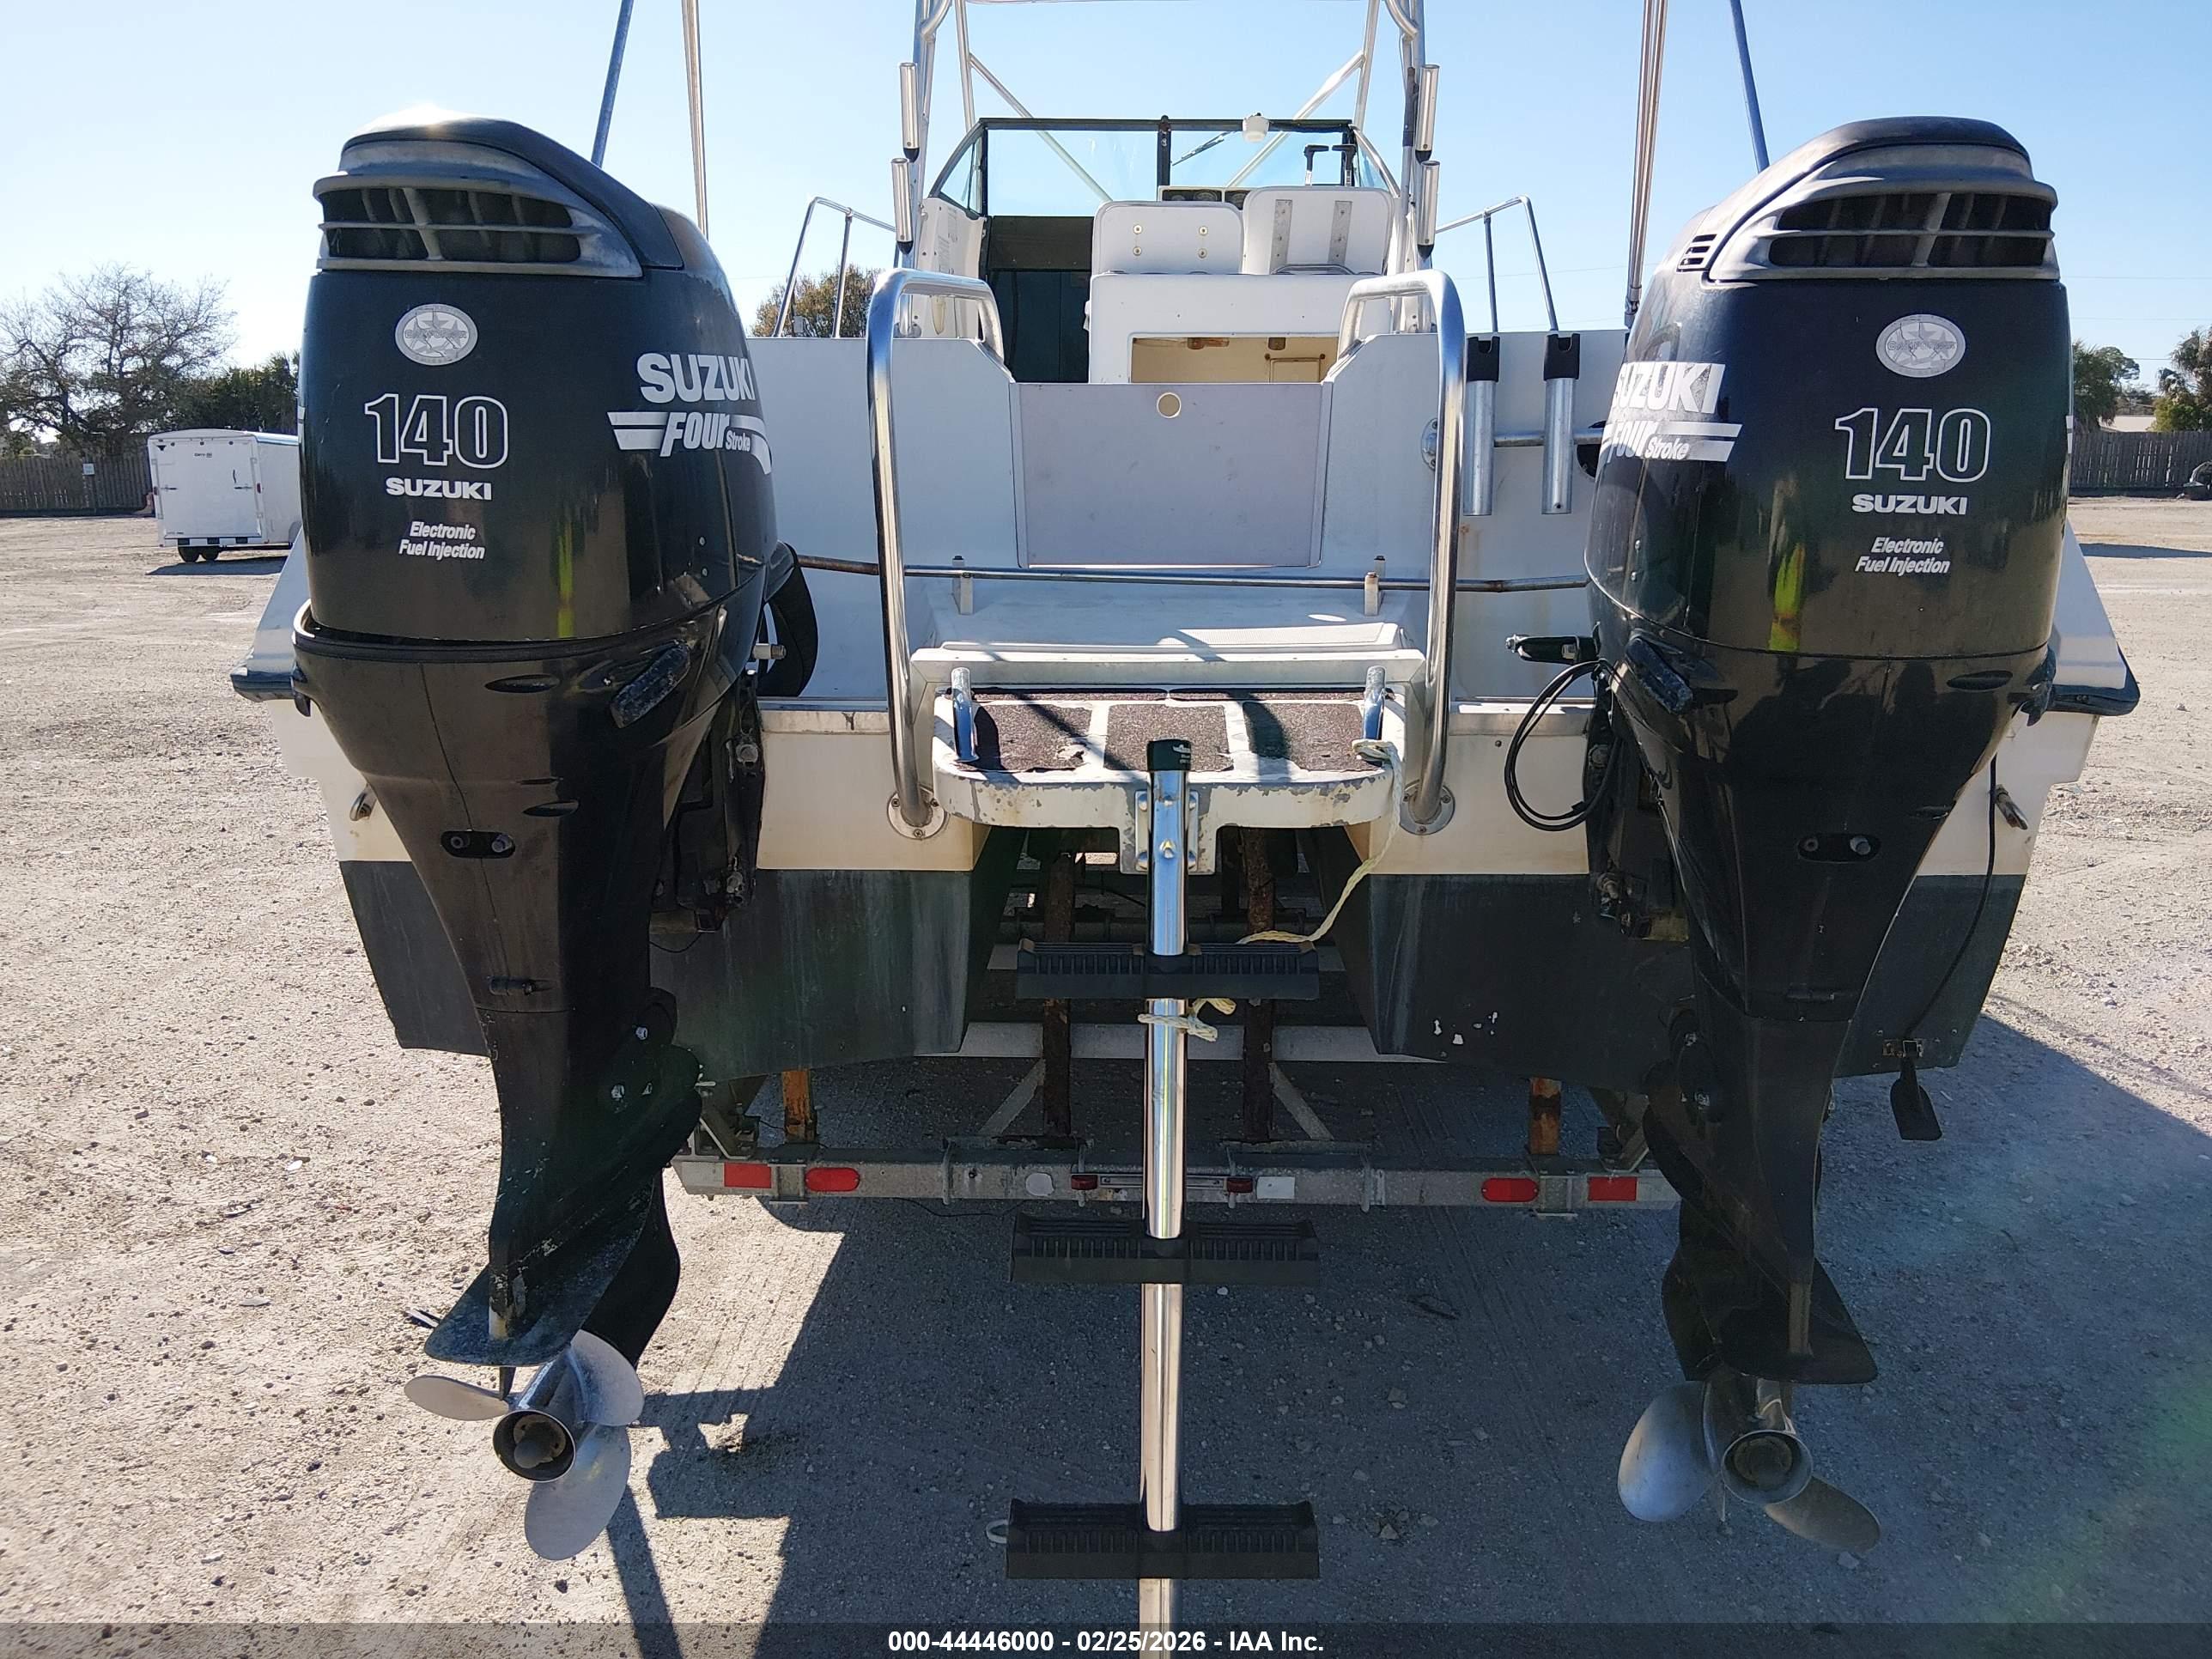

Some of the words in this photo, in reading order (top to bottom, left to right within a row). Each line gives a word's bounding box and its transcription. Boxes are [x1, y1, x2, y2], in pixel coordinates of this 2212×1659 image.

[636, 352, 757, 404] SUZUKI
[364, 392, 508, 469] 140
[725, 430, 751, 452] Stroke
[1644, 436, 1691, 460] Stroke
[1834, 407, 1991, 483] 140
[386, 477, 492, 501] SUZUKI
[1851, 494, 1968, 515] SUZUKI
[409, 520, 477, 540] Electronic
[398, 538, 428, 556] Fuel
[427, 540, 486, 561] Injection
[1870, 537, 1945, 555] Electronic
[1854, 556, 1891, 573] Fuel
[1887, 556, 1951, 577] Injection
